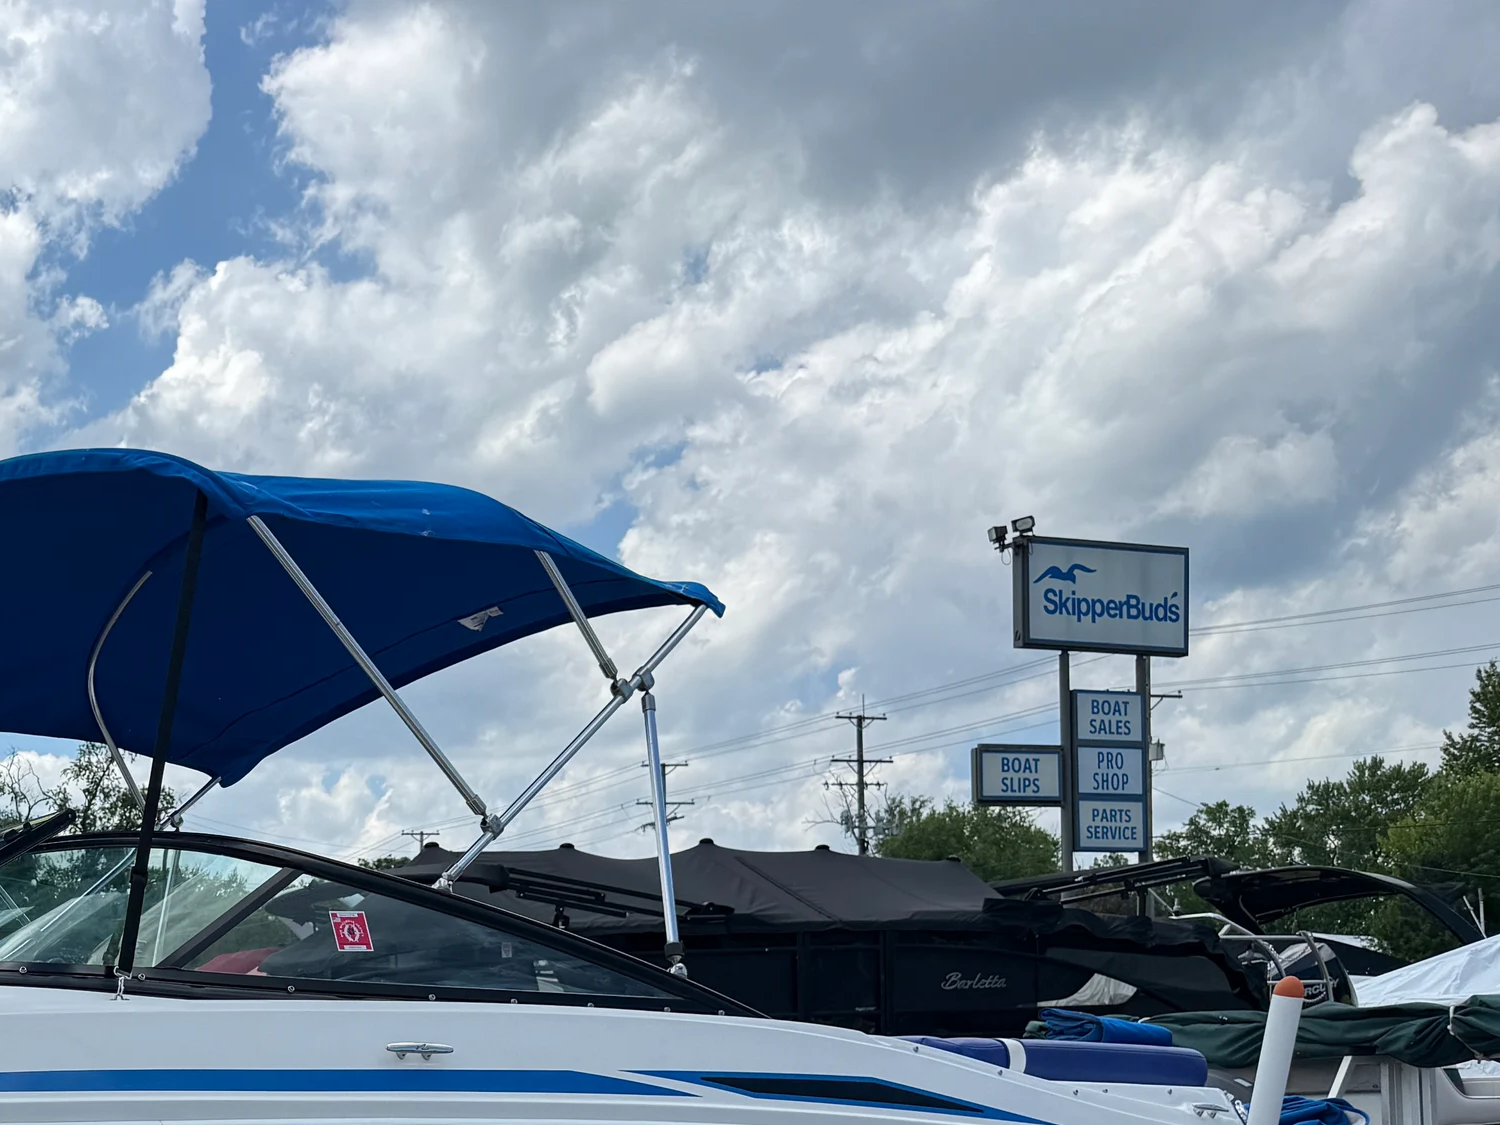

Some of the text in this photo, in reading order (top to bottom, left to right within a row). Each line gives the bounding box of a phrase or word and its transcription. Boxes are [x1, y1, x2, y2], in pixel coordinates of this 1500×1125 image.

[1091, 699, 1130, 717] BOAT
[1089, 718, 1132, 736] SALES
[1001, 756, 1041, 774] BOAT
[1097, 751, 1124, 770] PRO
[1001, 776, 1041, 794] SLIPS
[1092, 772, 1129, 791] SHOP
[1092, 808, 1132, 824] PARTS
[1086, 825, 1138, 841] SERVICE
[941, 972, 1007, 990] Barletta
